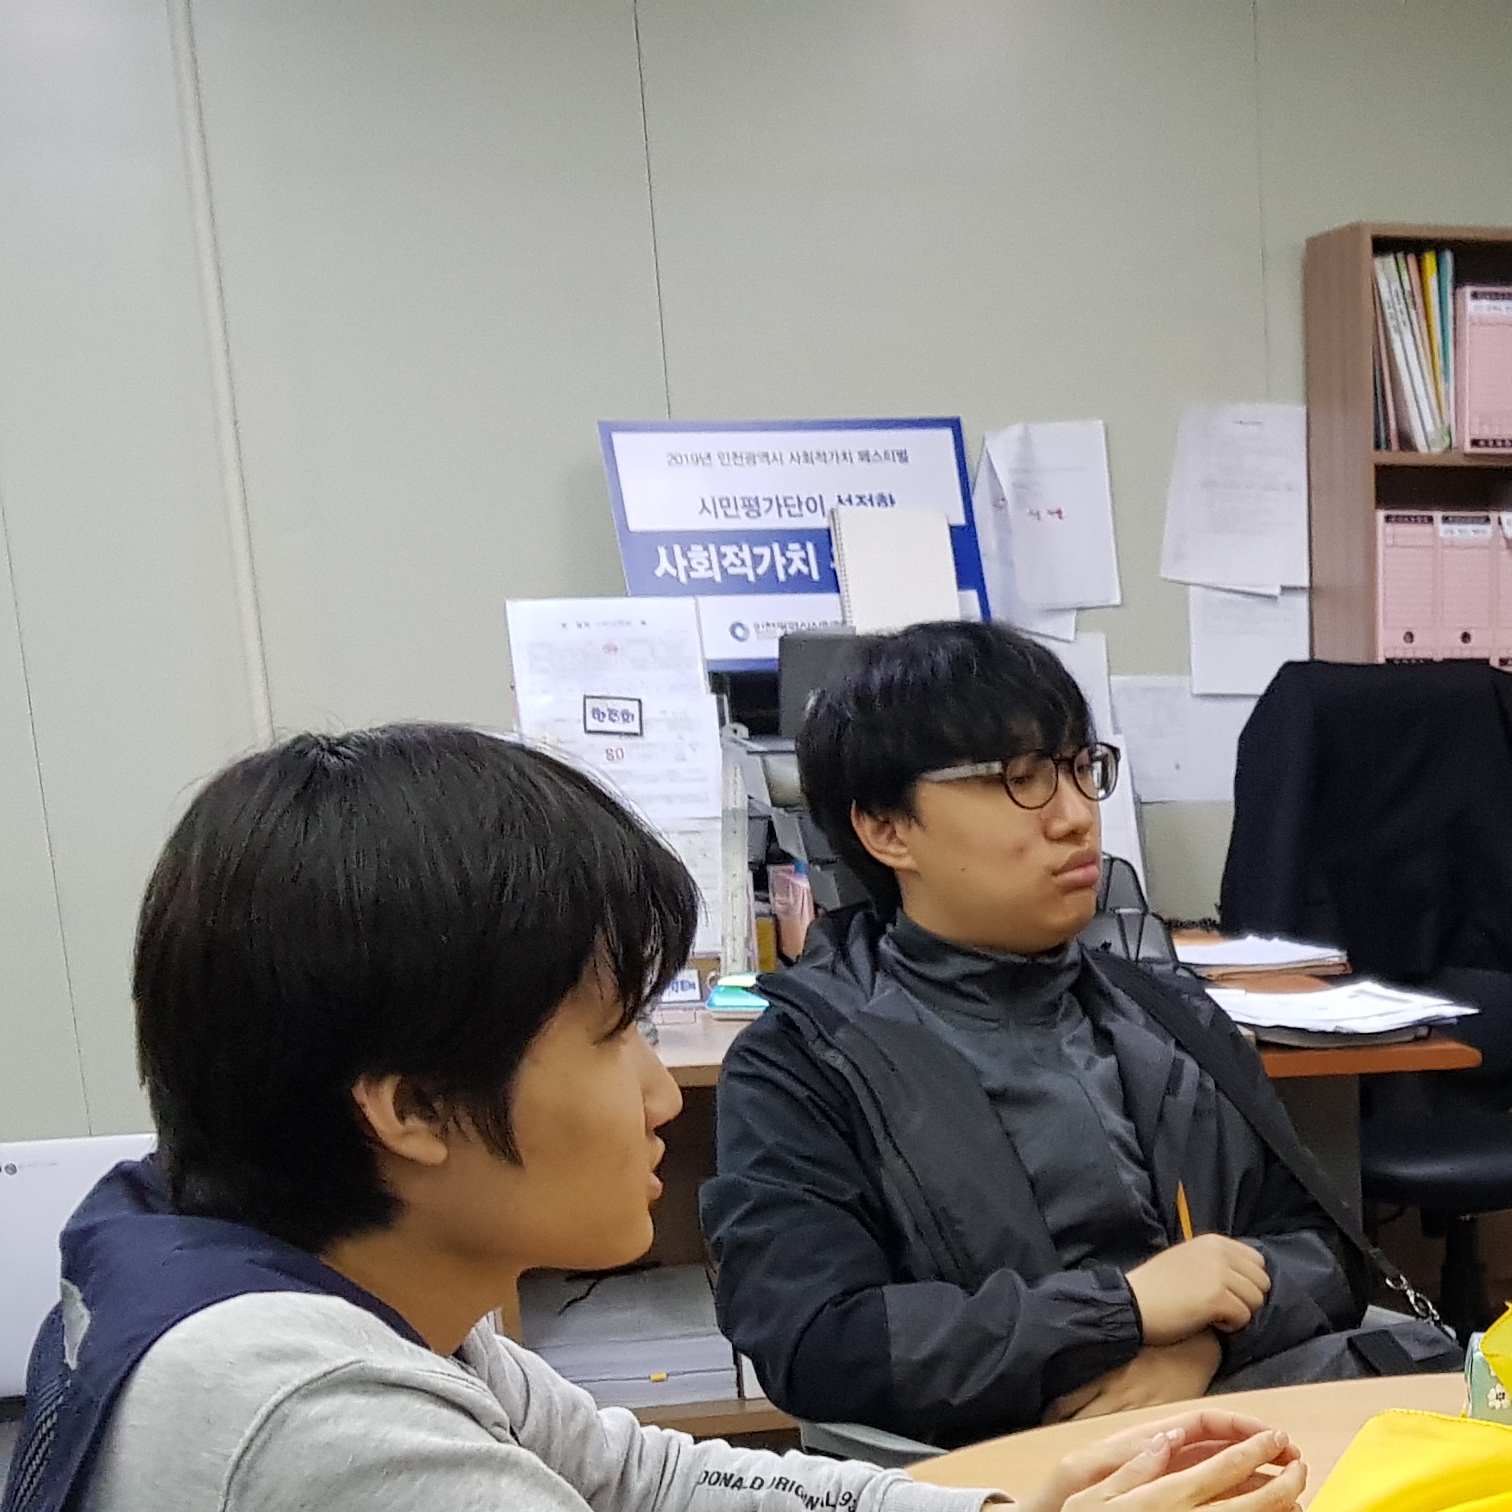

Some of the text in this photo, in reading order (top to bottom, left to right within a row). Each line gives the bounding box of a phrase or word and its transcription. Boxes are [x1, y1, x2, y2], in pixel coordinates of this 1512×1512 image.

[665, 446, 909, 467] 2019년 인천광역시 사회적가치 페스티벌
[699, 493, 826, 520] 시민평가단이
[653, 540, 821, 586] 사회적가치
[768, 1476, 836, 1511] RIGNL
